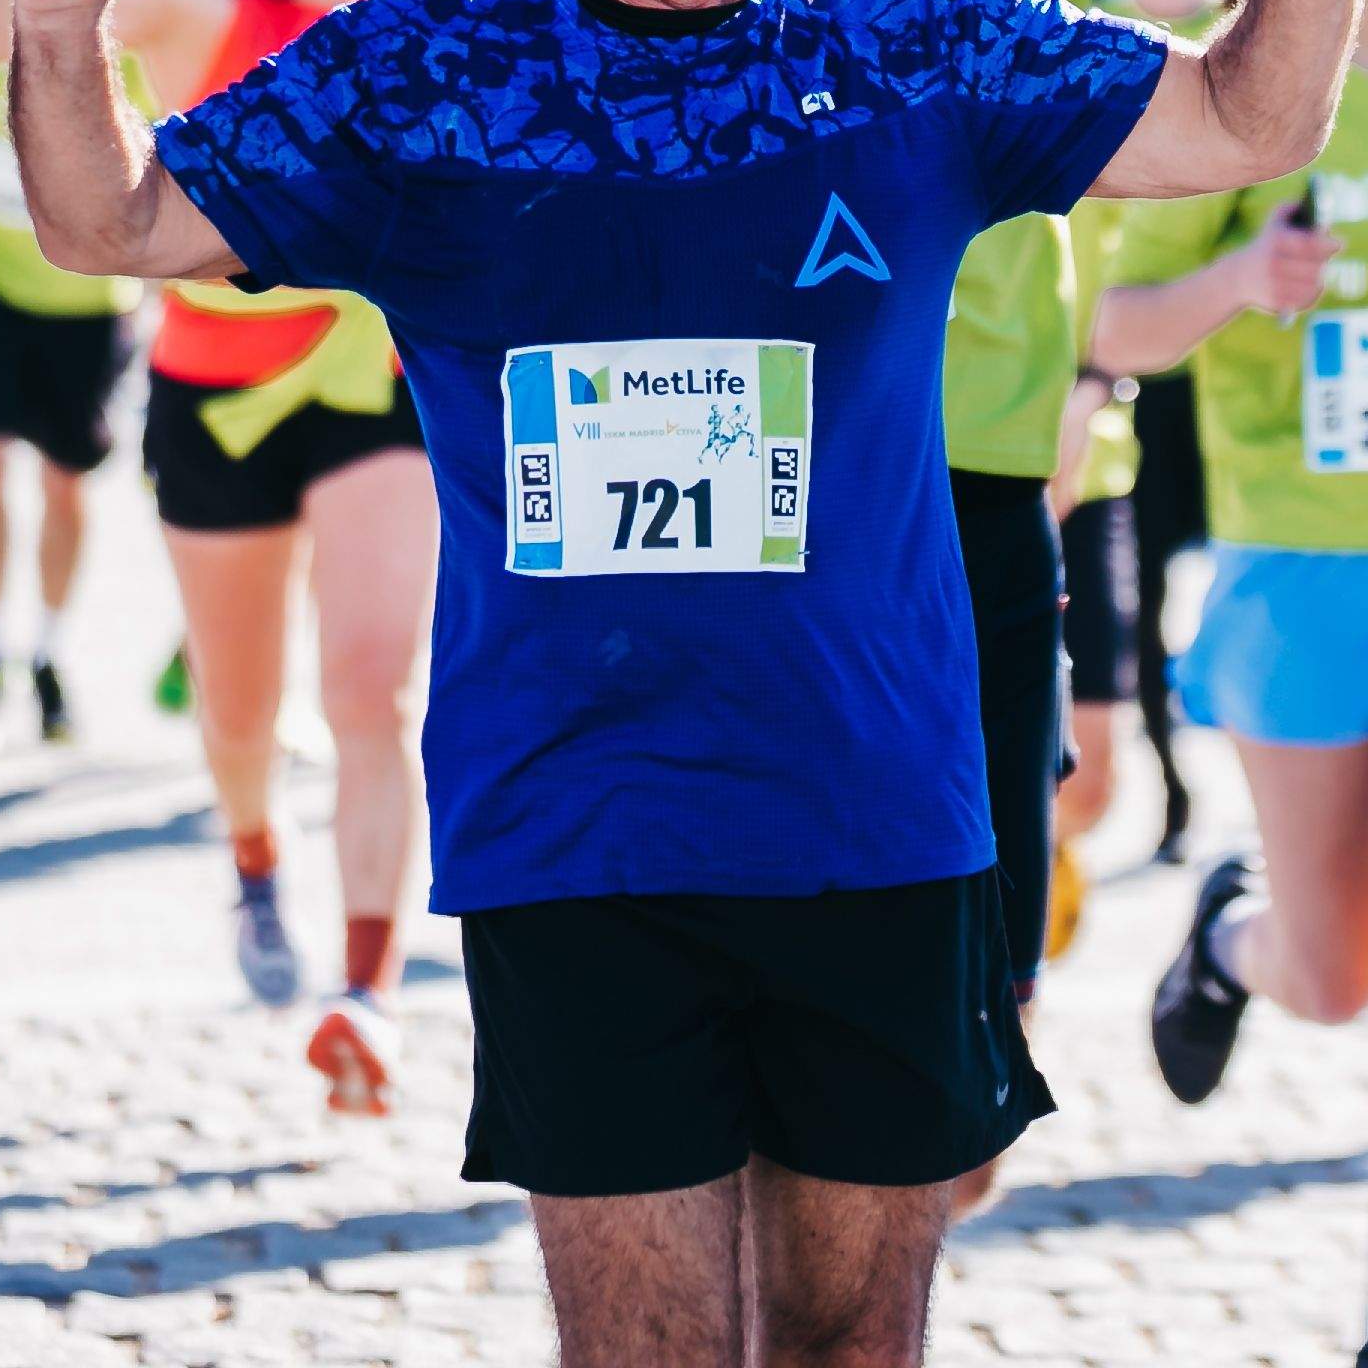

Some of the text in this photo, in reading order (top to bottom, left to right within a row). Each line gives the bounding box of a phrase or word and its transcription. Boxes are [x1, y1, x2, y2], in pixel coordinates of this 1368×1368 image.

[623, 368, 746, 397] MetLife
[573, 422, 601, 440] VIII
[606, 478, 713, 551] 721
